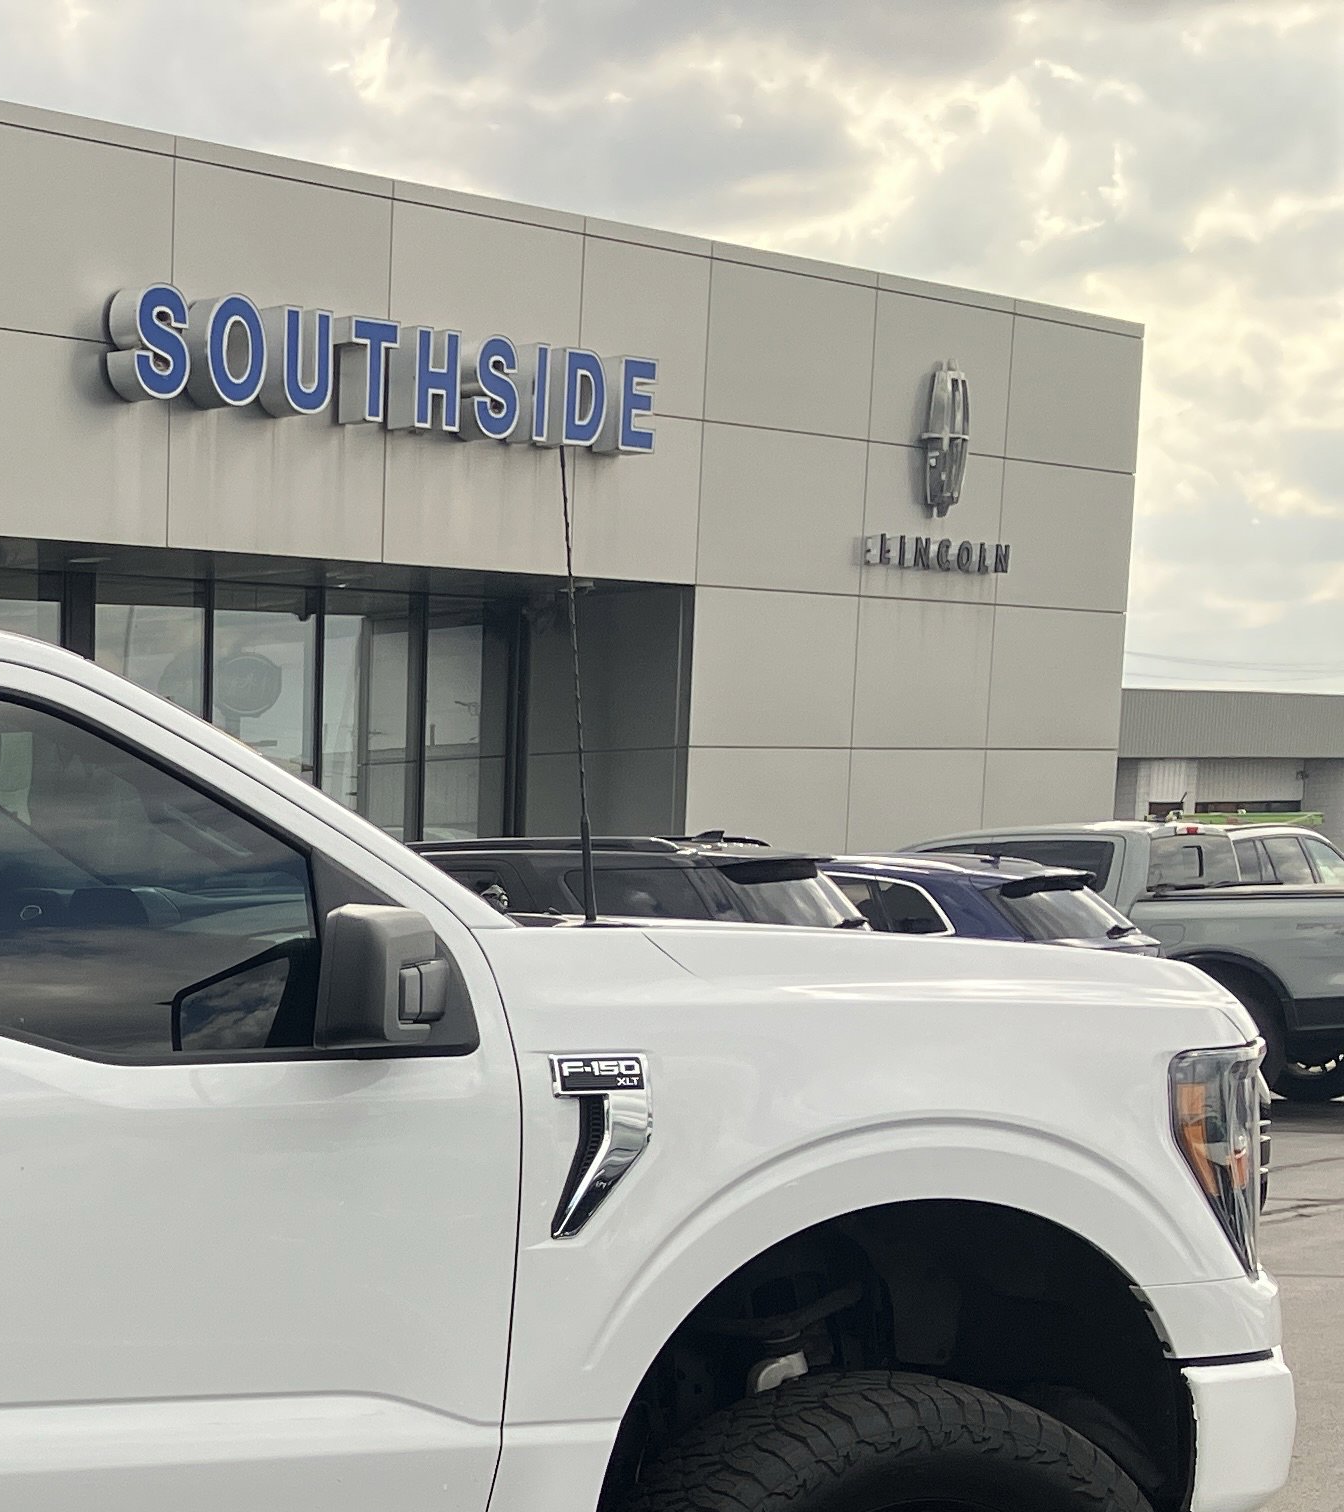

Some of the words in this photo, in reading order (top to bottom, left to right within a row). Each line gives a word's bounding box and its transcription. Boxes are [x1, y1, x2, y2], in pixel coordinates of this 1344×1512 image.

[130, 280, 660, 454] SOUTHSIDE
[876, 532, 1011, 574] LINCOLN
[562, 1060, 641, 1077] F-150
[616, 1076, 640, 1086] XLT
